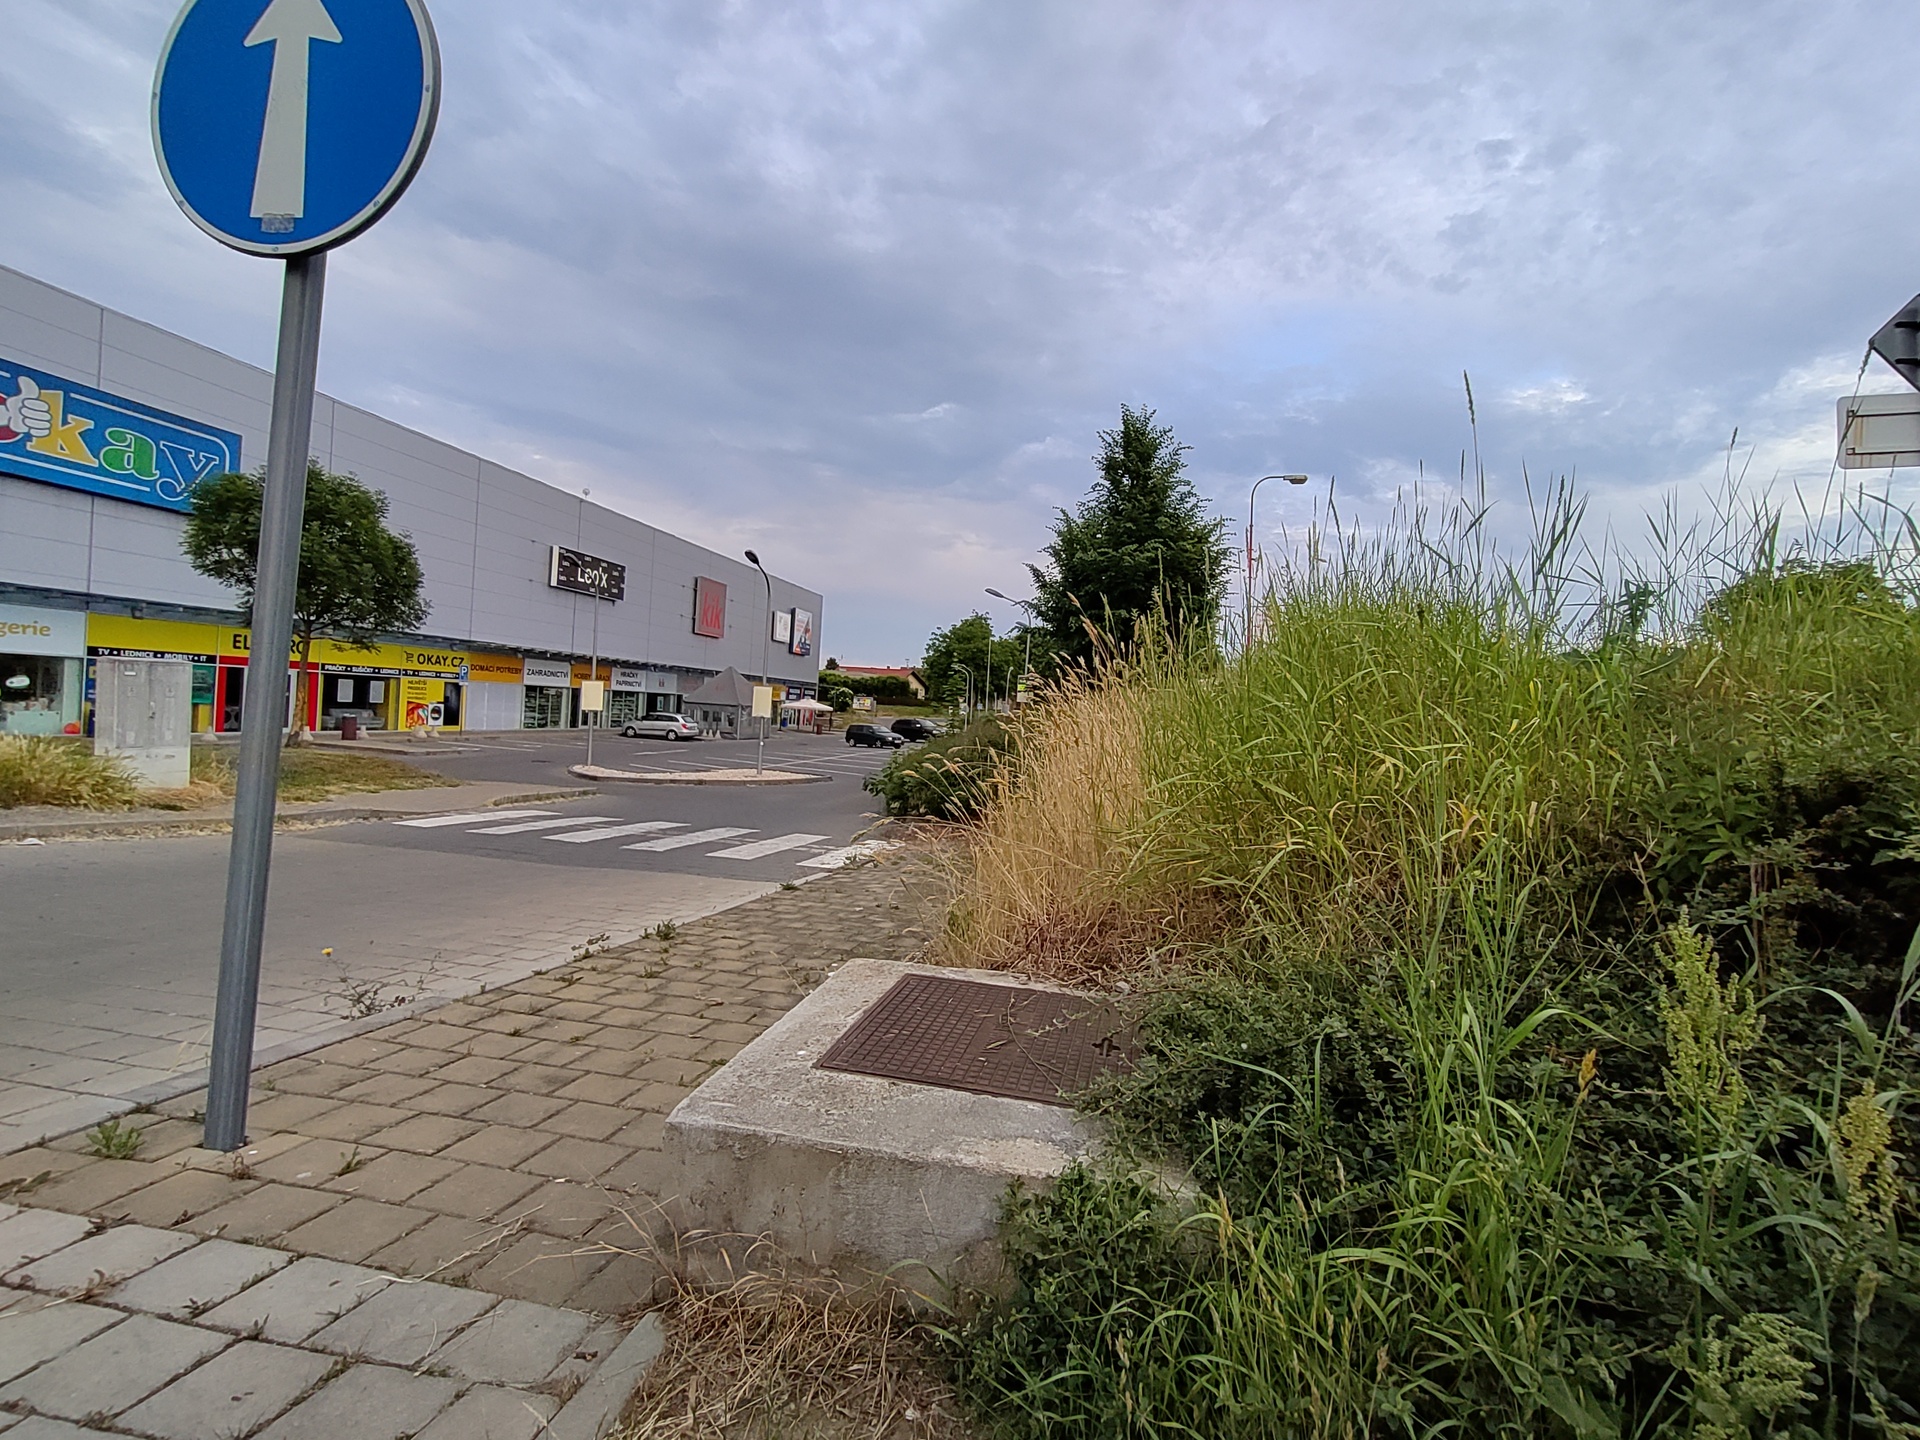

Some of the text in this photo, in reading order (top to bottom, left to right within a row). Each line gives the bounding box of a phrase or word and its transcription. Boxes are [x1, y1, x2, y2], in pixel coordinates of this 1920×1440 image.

[0, 390, 220, 501] kay
[701, 591, 722, 630] kik
[98, 648, 110, 656] TV
[120, 649, 154, 659] LEDNICE
[417, 652, 465, 667] OKAY.CZ
[461, 666, 468, 677] P
[526, 667, 569, 679] ZAHRADNICTVÍ
